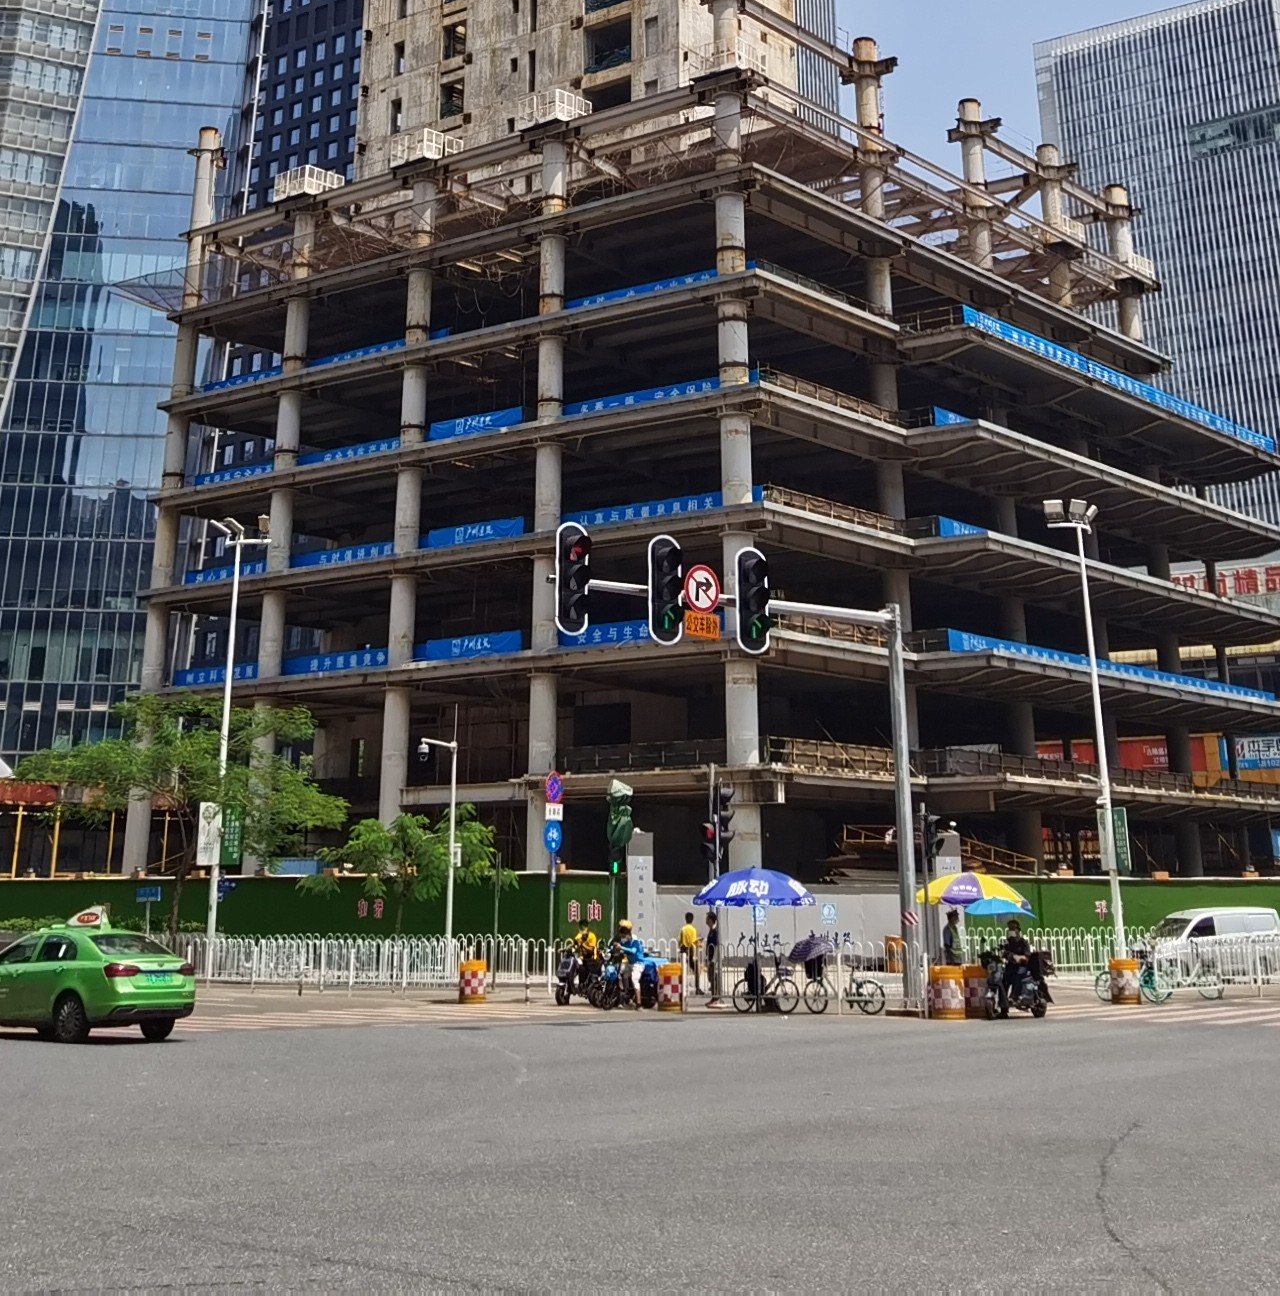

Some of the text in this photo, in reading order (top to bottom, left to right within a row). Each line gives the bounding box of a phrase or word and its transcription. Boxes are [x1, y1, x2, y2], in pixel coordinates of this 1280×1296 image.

[686, 613, 721, 640] 公交车除外
[726, 879, 769, 898] 脉动
[568, 899, 601, 922] 自由
